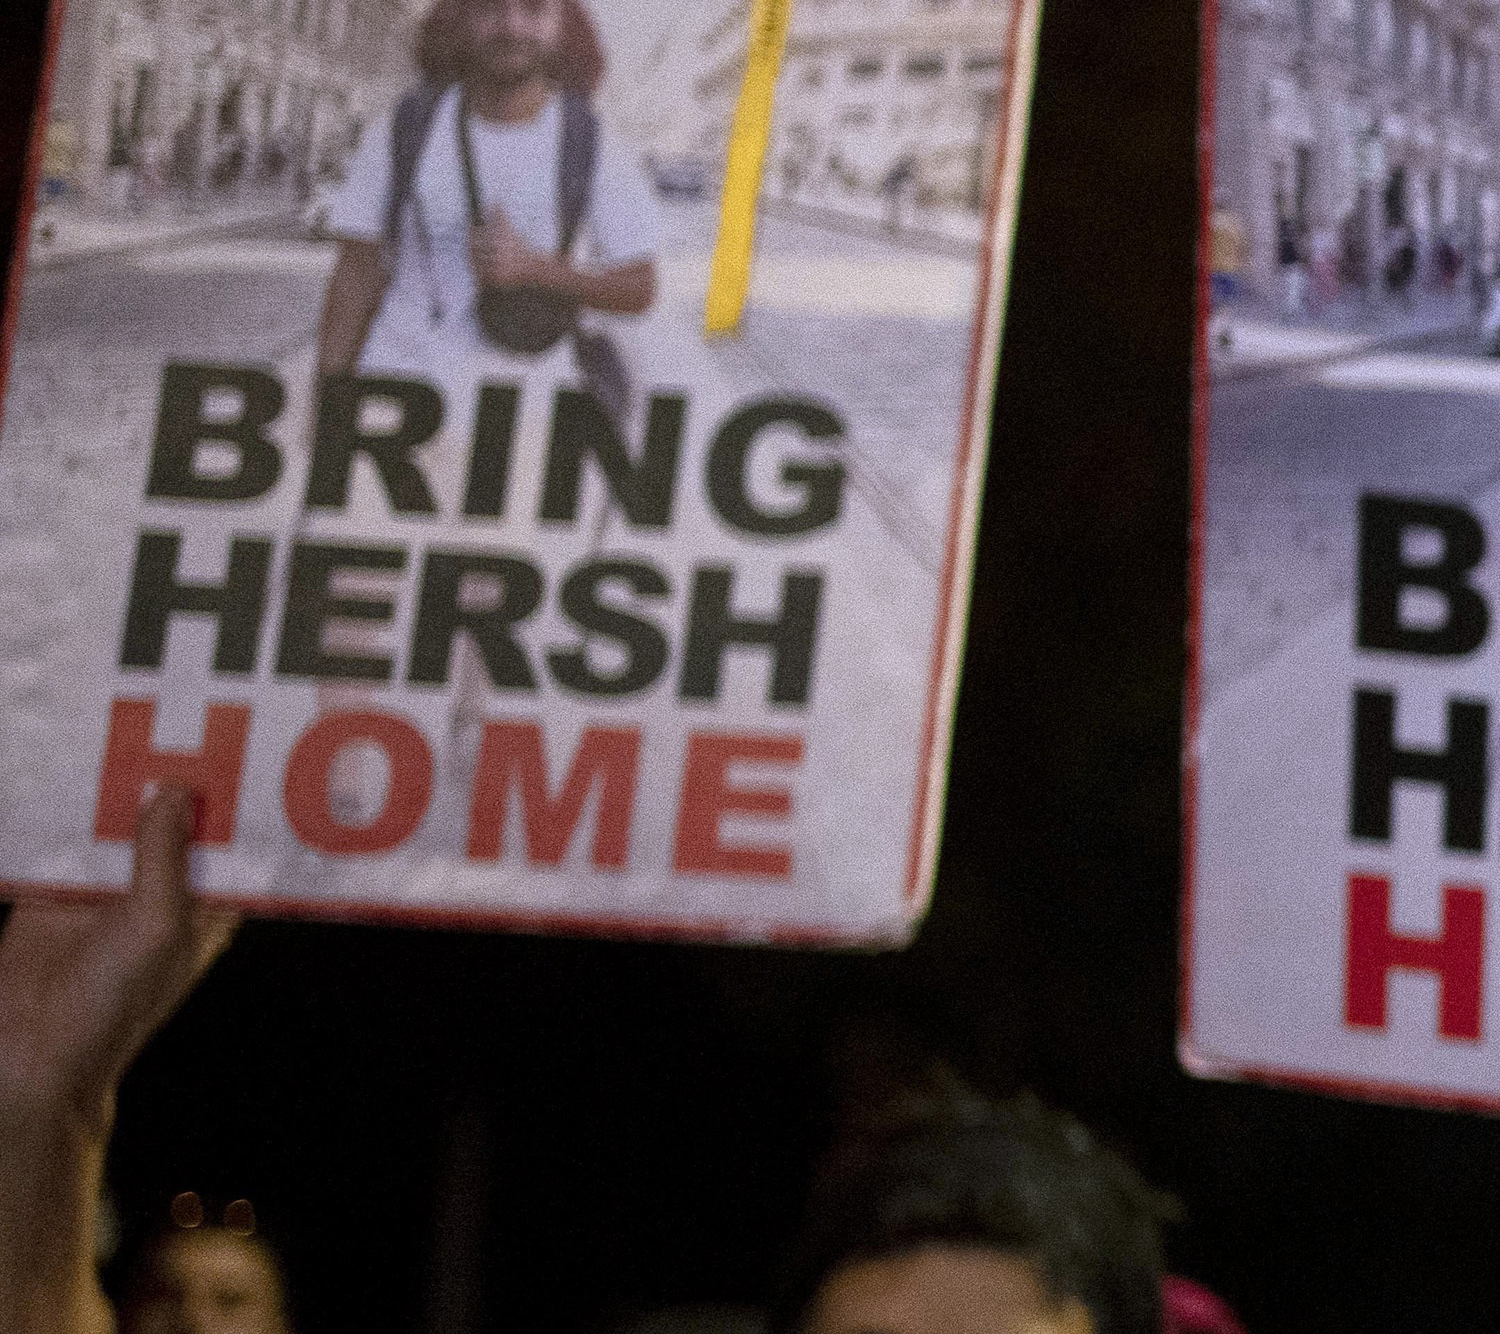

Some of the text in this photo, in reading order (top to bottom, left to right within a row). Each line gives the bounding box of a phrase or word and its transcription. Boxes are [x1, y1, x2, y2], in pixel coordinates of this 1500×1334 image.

[145, 360, 849, 540] BRING
[117, 529, 825, 710] HERSH
[92, 696, 805, 876] HOME
